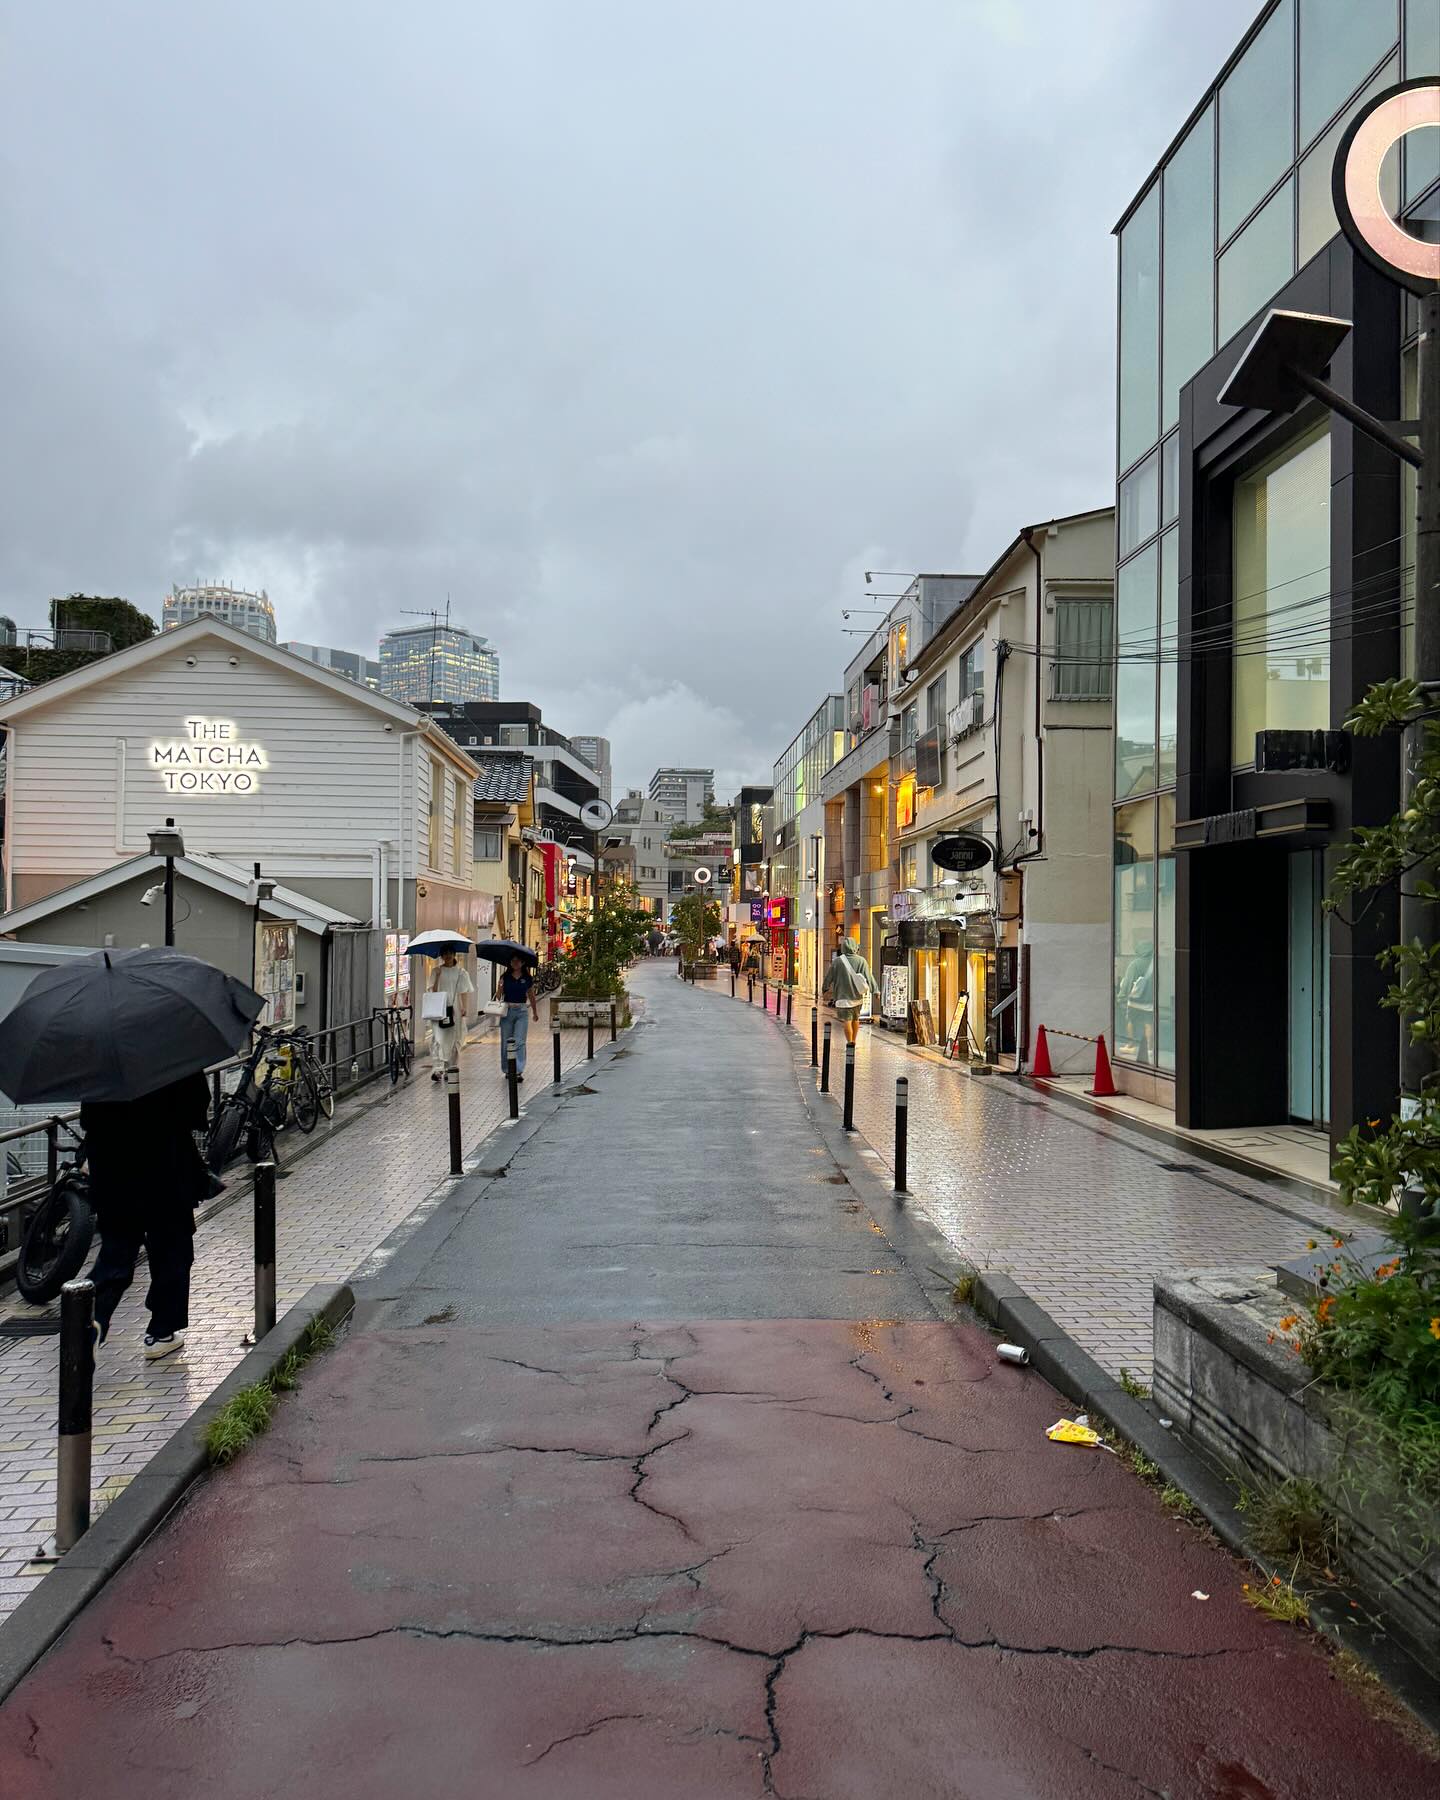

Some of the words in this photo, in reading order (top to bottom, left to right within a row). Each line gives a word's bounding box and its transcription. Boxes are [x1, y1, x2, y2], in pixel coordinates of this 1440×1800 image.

[188, 721, 230, 739] THE
[154, 746, 262, 765] MATCHA
[165, 772, 252, 790] TOKYO
